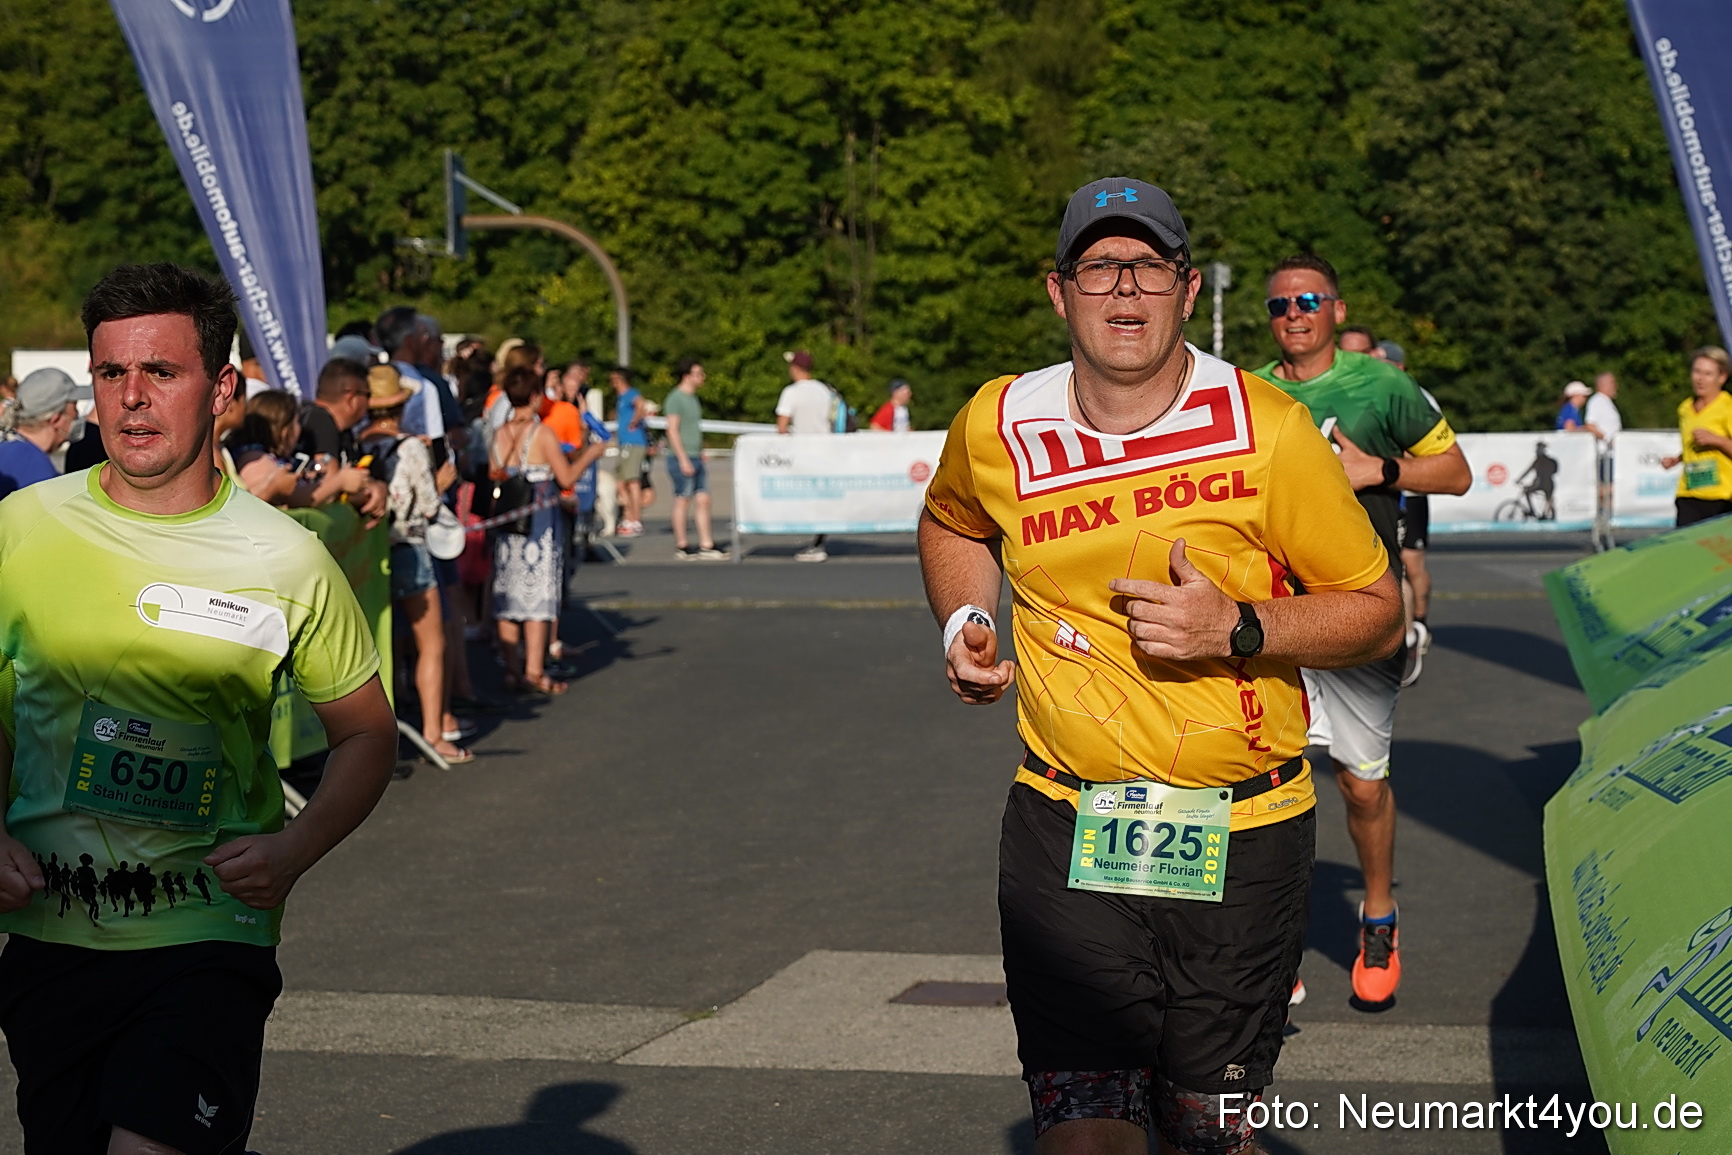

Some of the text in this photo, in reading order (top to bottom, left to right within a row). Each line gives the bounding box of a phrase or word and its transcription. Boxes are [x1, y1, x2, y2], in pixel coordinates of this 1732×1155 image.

[1022, 470, 1257, 546] MAX BÖGL
[207, 607, 247, 622] Neumarkt
[209, 597, 249, 614] Klinikum
[117, 732, 166, 748] Firmenlauf
[135, 742, 164, 752] neumarkt
[76, 753, 96, 792] RUN
[110, 750, 188, 795] 650
[92, 783, 129, 803] Stahl
[132, 793, 195, 811] Christian
[198, 768, 217, 816] 2022
[1117, 801, 1164, 810] Firmenlauf
[1080, 829, 1097, 868] RUN
[1101, 818, 1203, 861] 1625
[1094, 857, 1203, 878] Neumeier Florian
[1204, 833, 1221, 884] 2022
[1650, 1017, 1721, 1079] neumarkt
[1223, 1069, 1246, 1081] PRO
